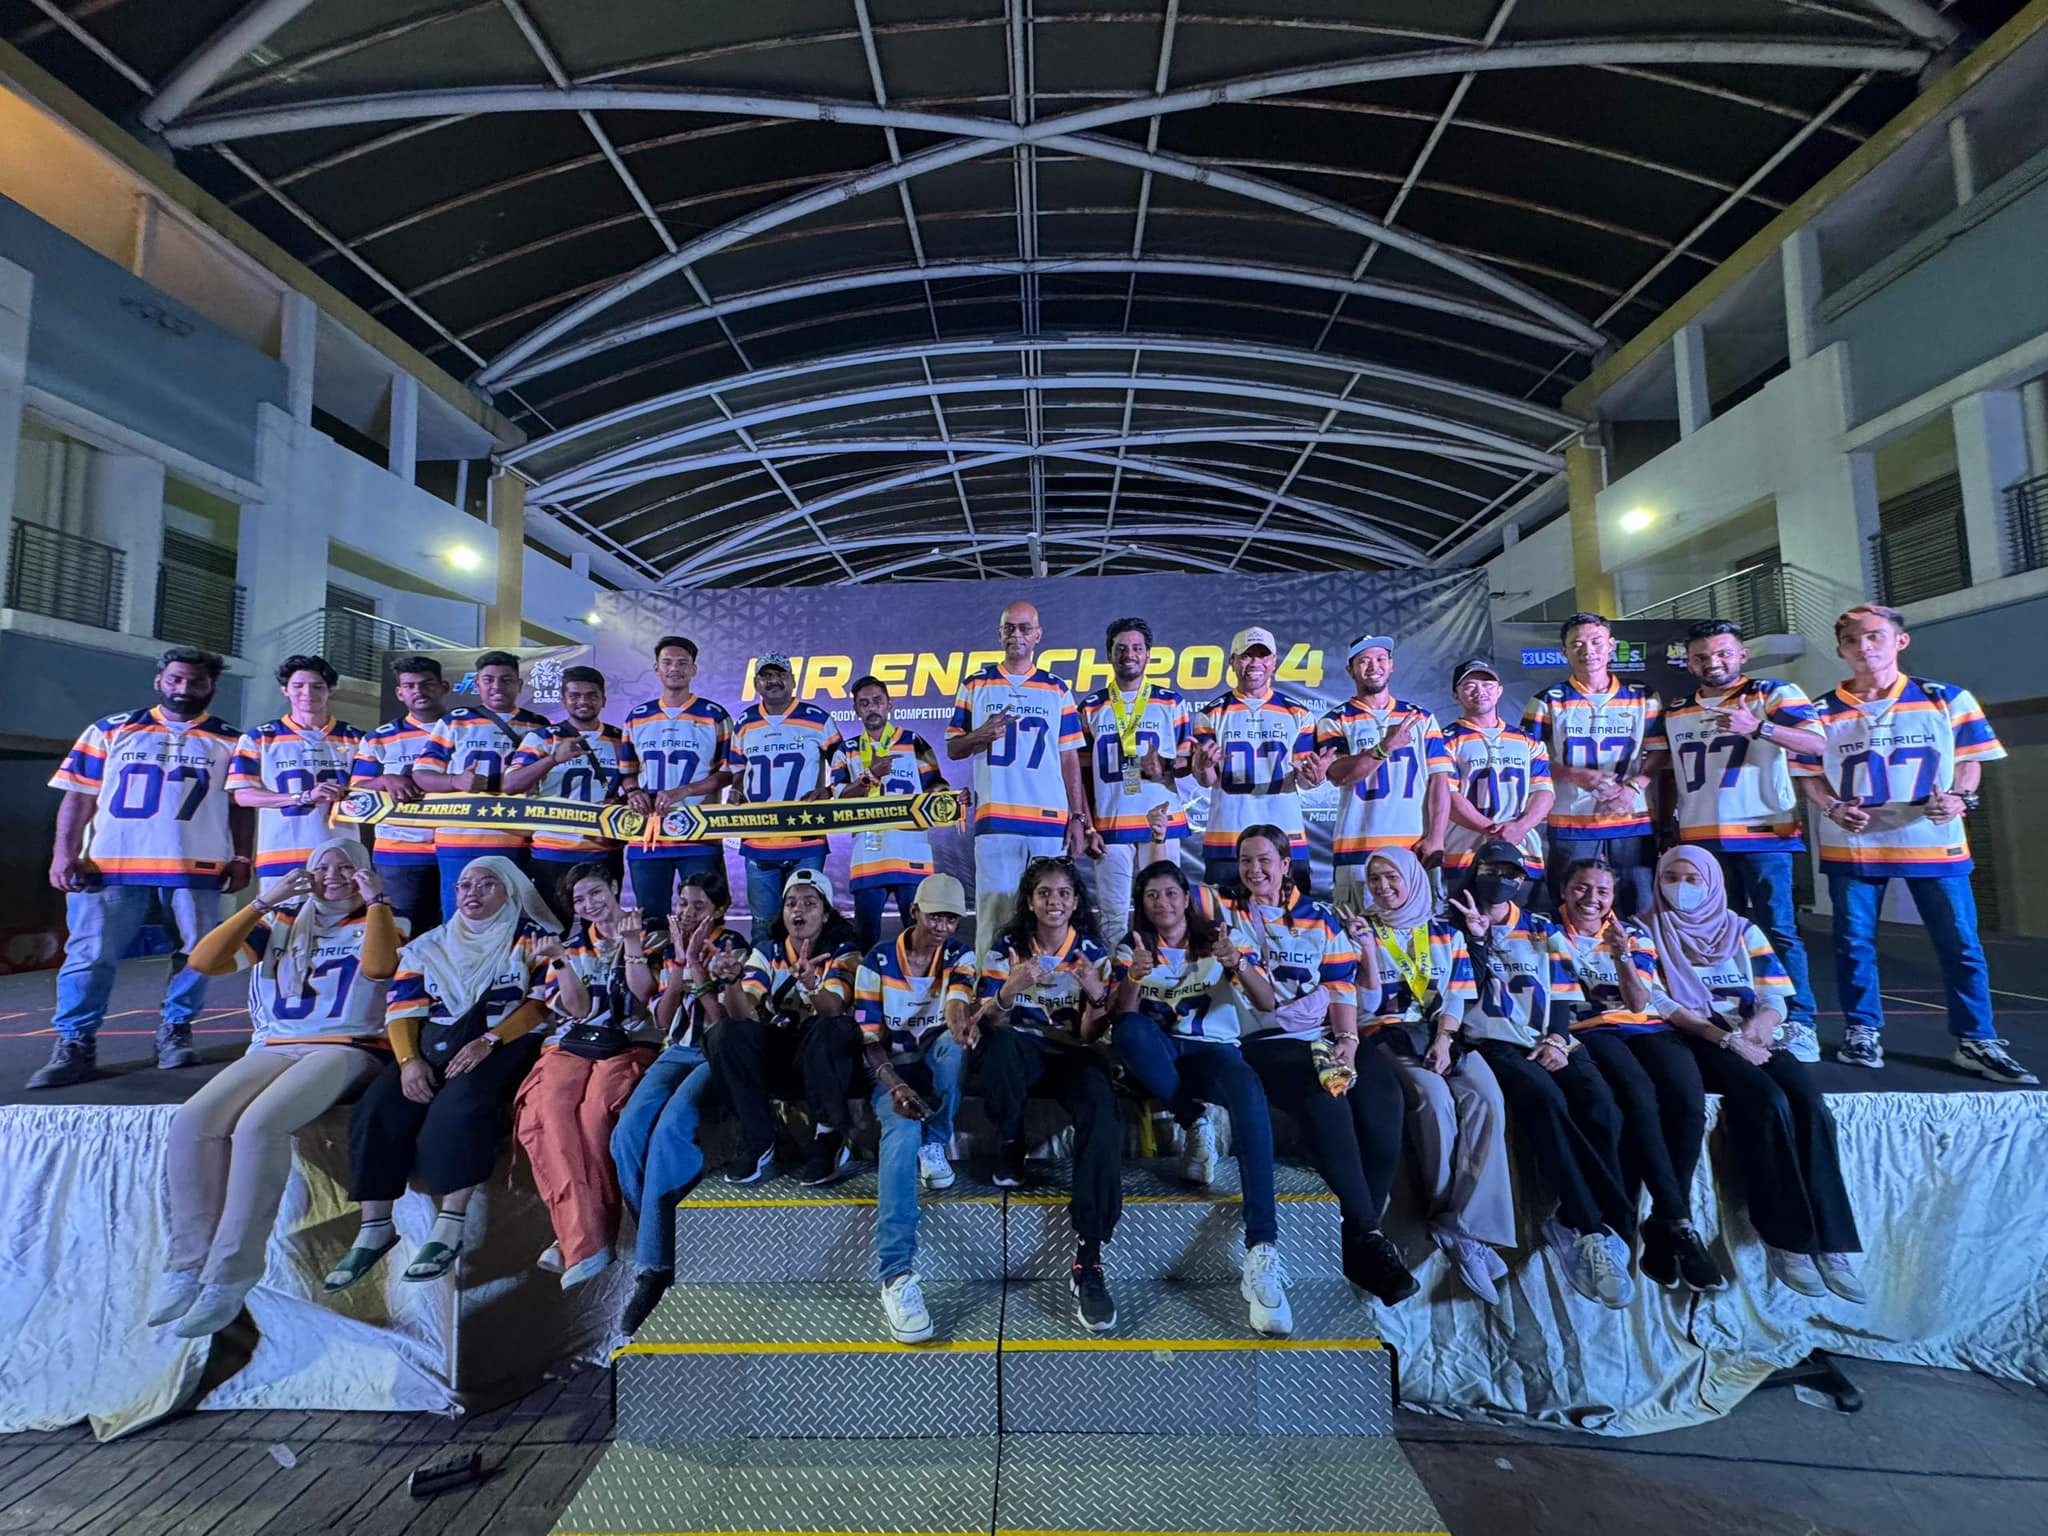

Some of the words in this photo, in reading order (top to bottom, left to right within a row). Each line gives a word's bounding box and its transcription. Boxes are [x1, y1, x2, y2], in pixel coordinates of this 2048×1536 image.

[534, 689, 560, 698] OLD
[451, 708, 469, 717] 0
[894, 707, 956, 720] COMPETITIO
[1008, 705, 1049, 717] ENRICH
[1097, 724, 1115, 733] MR
[1224, 731, 1241, 739] MR
[1247, 730, 1288, 739] ENRICH
[1566, 726, 1583, 734] MR
[1589, 726, 1633, 734] ENRICH
[986, 714, 1049, 770] 07
[1356, 738, 1375, 747] MR
[1674, 731, 1695, 742] MR
[466, 740, 488, 749] MR
[641, 740, 657, 749] MR
[662, 739, 699, 749] ENRICH
[763, 742, 805, 752] ENRICH
[1839, 742, 1864, 754] MR
[1869, 733, 1936, 747] ENRICH
[121, 752, 148, 762] MR
[155, 753, 216, 767] ENRICH
[275, 760, 297, 769] MR
[303, 759, 348, 768] ENRICH
[1470, 758, 1486, 769] MR
[1678, 735, 1750, 794] 07
[643, 750, 700, 795] 07
[1221, 741, 1288, 795] 07
[748, 752, 806, 801] 07
[1840, 746, 1941, 807] 07
[108, 763, 211, 821] 07
[1269, 950, 1313, 964] NRICH
[1493, 962, 1539, 974] ENRICH
[1702, 973, 1750, 985] NRICH
[1140, 985, 1159, 997] MR
[1164, 981, 1211, 999] ENRICH
